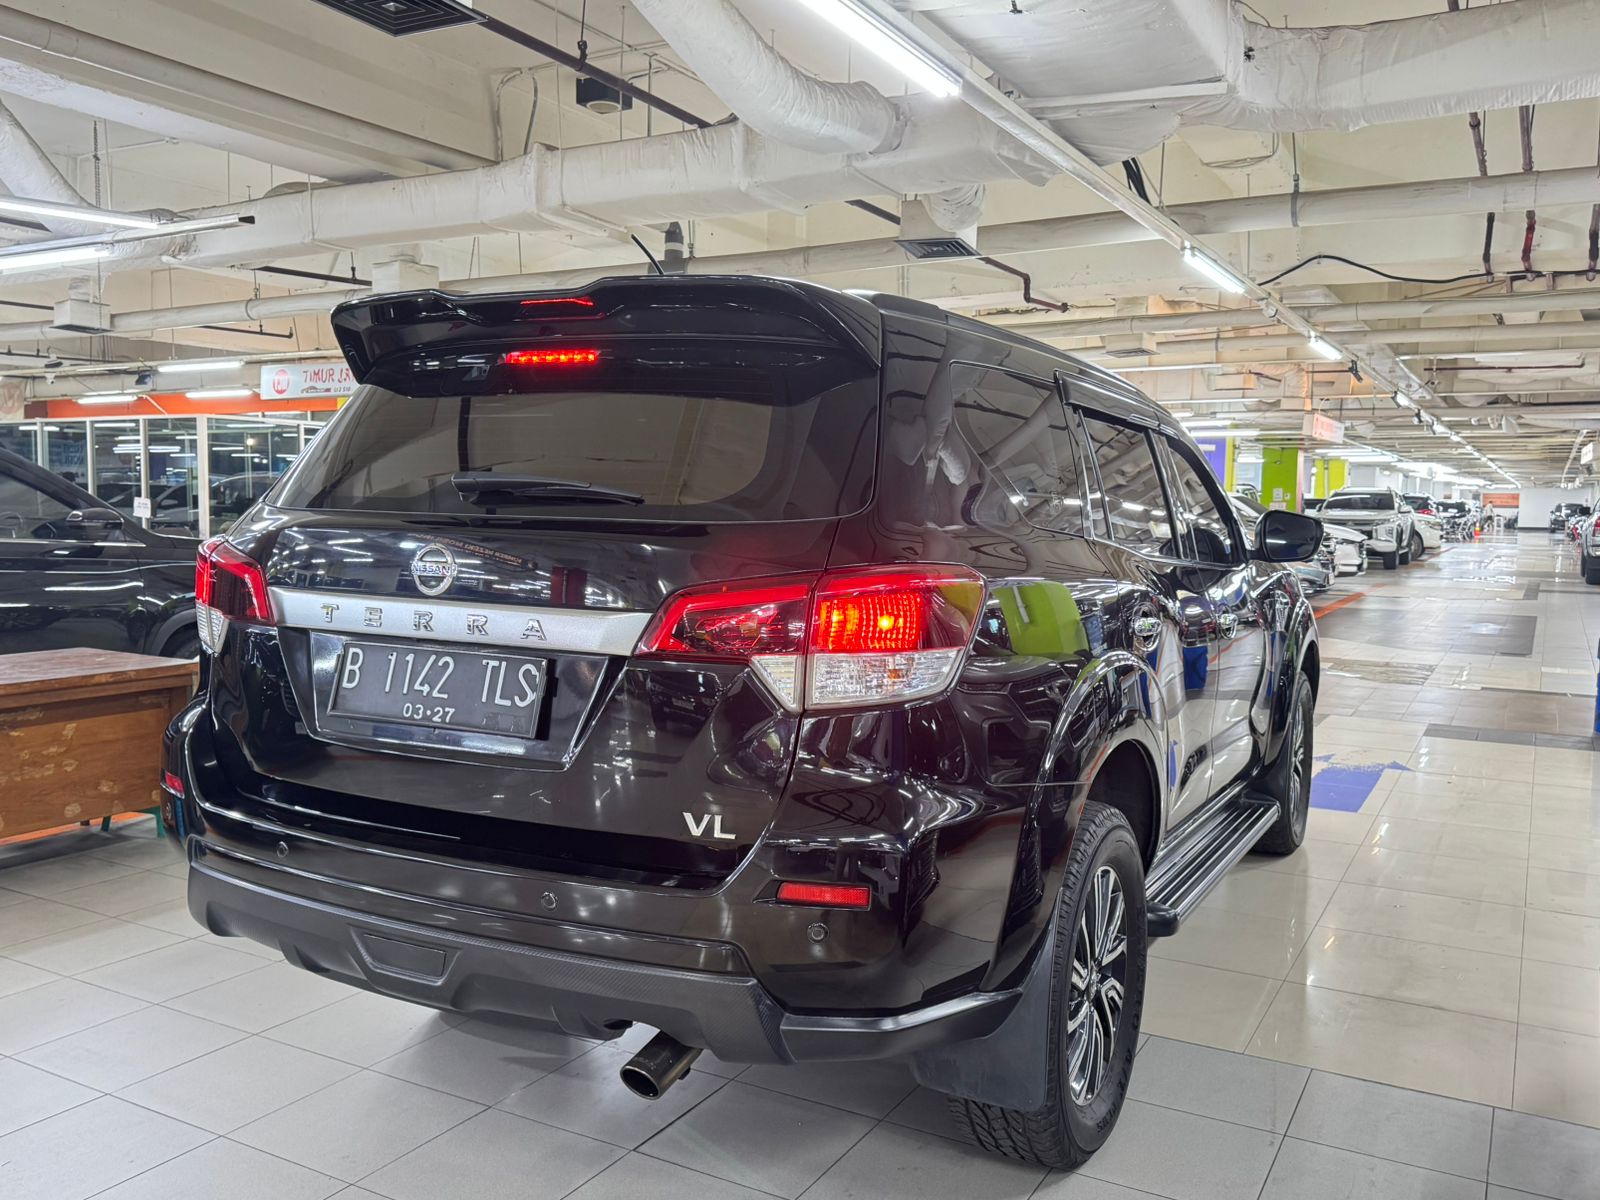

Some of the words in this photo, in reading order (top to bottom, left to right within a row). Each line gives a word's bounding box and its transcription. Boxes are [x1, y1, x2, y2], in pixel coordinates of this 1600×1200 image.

[302, 367, 335, 384] TIMUR
[411, 564, 450, 576] NISSAN
[320, 603, 547, 641] TERRA
[342, 647, 364, 689] B
[384, 651, 455, 699] 1142
[481, 659, 540, 708] TLS
[682, 811, 737, 840] VL
